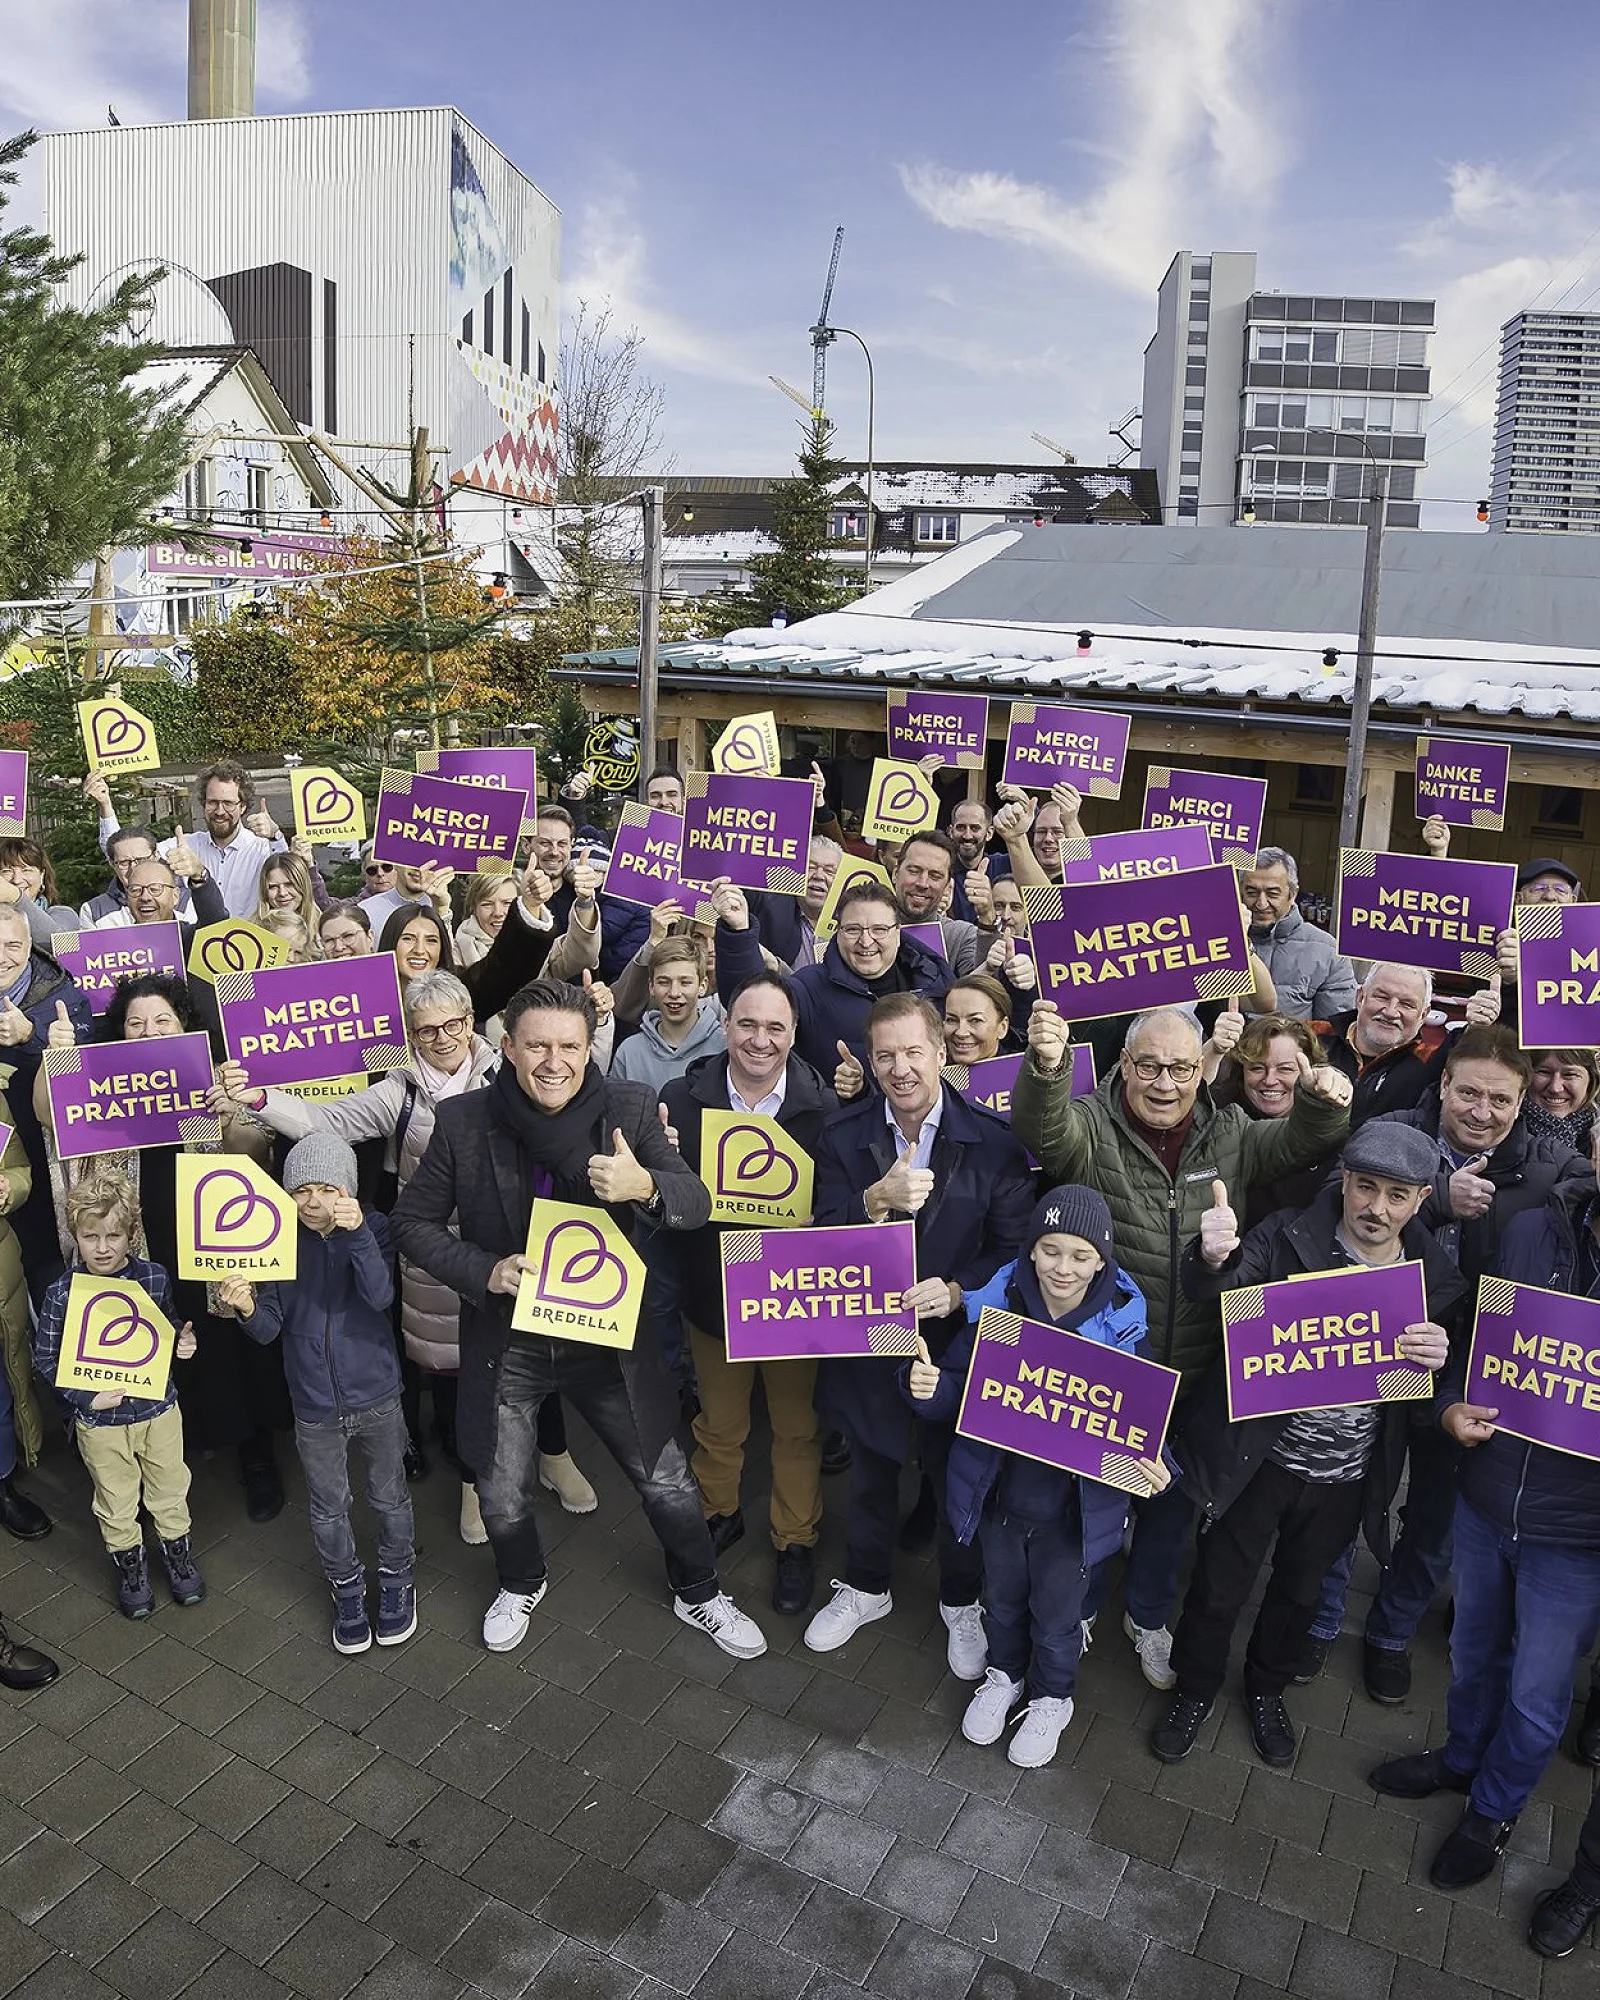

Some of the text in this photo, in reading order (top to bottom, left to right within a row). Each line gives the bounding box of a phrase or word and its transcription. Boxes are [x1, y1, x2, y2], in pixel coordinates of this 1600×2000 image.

[908, 713, 963, 729] MERCI
[894, 727, 979, 747] PRATTELE
[1035, 730, 1099, 751] MERCI
[98, 755, 150, 769] BREDELLA
[1015, 746, 1117, 773] PRATTELE
[1426, 763, 1482, 783] DANKE
[443, 774, 507, 789] ERCI
[1419, 780, 1497, 804] PRATTELE
[412, 803, 490, 830] MERCI
[707, 806, 776, 832] MERCI
[1169, 796, 1232, 820] MERCI
[306, 826, 356, 837] BREDELLA
[387, 819, 508, 850] PRATTELE
[873, 823, 914, 835] BREDEL
[689, 829, 798, 859] PRATTELE
[1099, 856, 1179, 880] MERCI
[1379, 886, 1470, 917] MERCI
[1074, 914, 1192, 954] MERCI
[1351, 907, 1496, 946] PRATTELE
[85, 948, 154, 971] MERCI
[1049, 937, 1232, 989] PRATTELE
[263, 993, 361, 1028] MERCI
[239, 1015, 392, 1058] PRATTELE
[88, 1069, 178, 1098] MERCI
[285, 1086, 355, 1099] BREDELLA
[65, 1089, 207, 1126] PRATTELE
[716, 1199, 796, 1218] BREDELLA
[194, 1256, 281, 1271] BREDELLA
[769, 1264, 872, 1292] MERCI
[532, 1306, 620, 1333] BREDELLA
[740, 1291, 903, 1323] PRATTELE
[1272, 1310, 1381, 1346] MERCI
[1513, 1328, 1600, 1377] MERC
[73, 1366, 152, 1386] BREDELLA
[1017, 1359, 1125, 1414] MERCI
[1482, 1354, 1600, 1412] PRATTE
[981, 1376, 1148, 1452] PRATTELE
